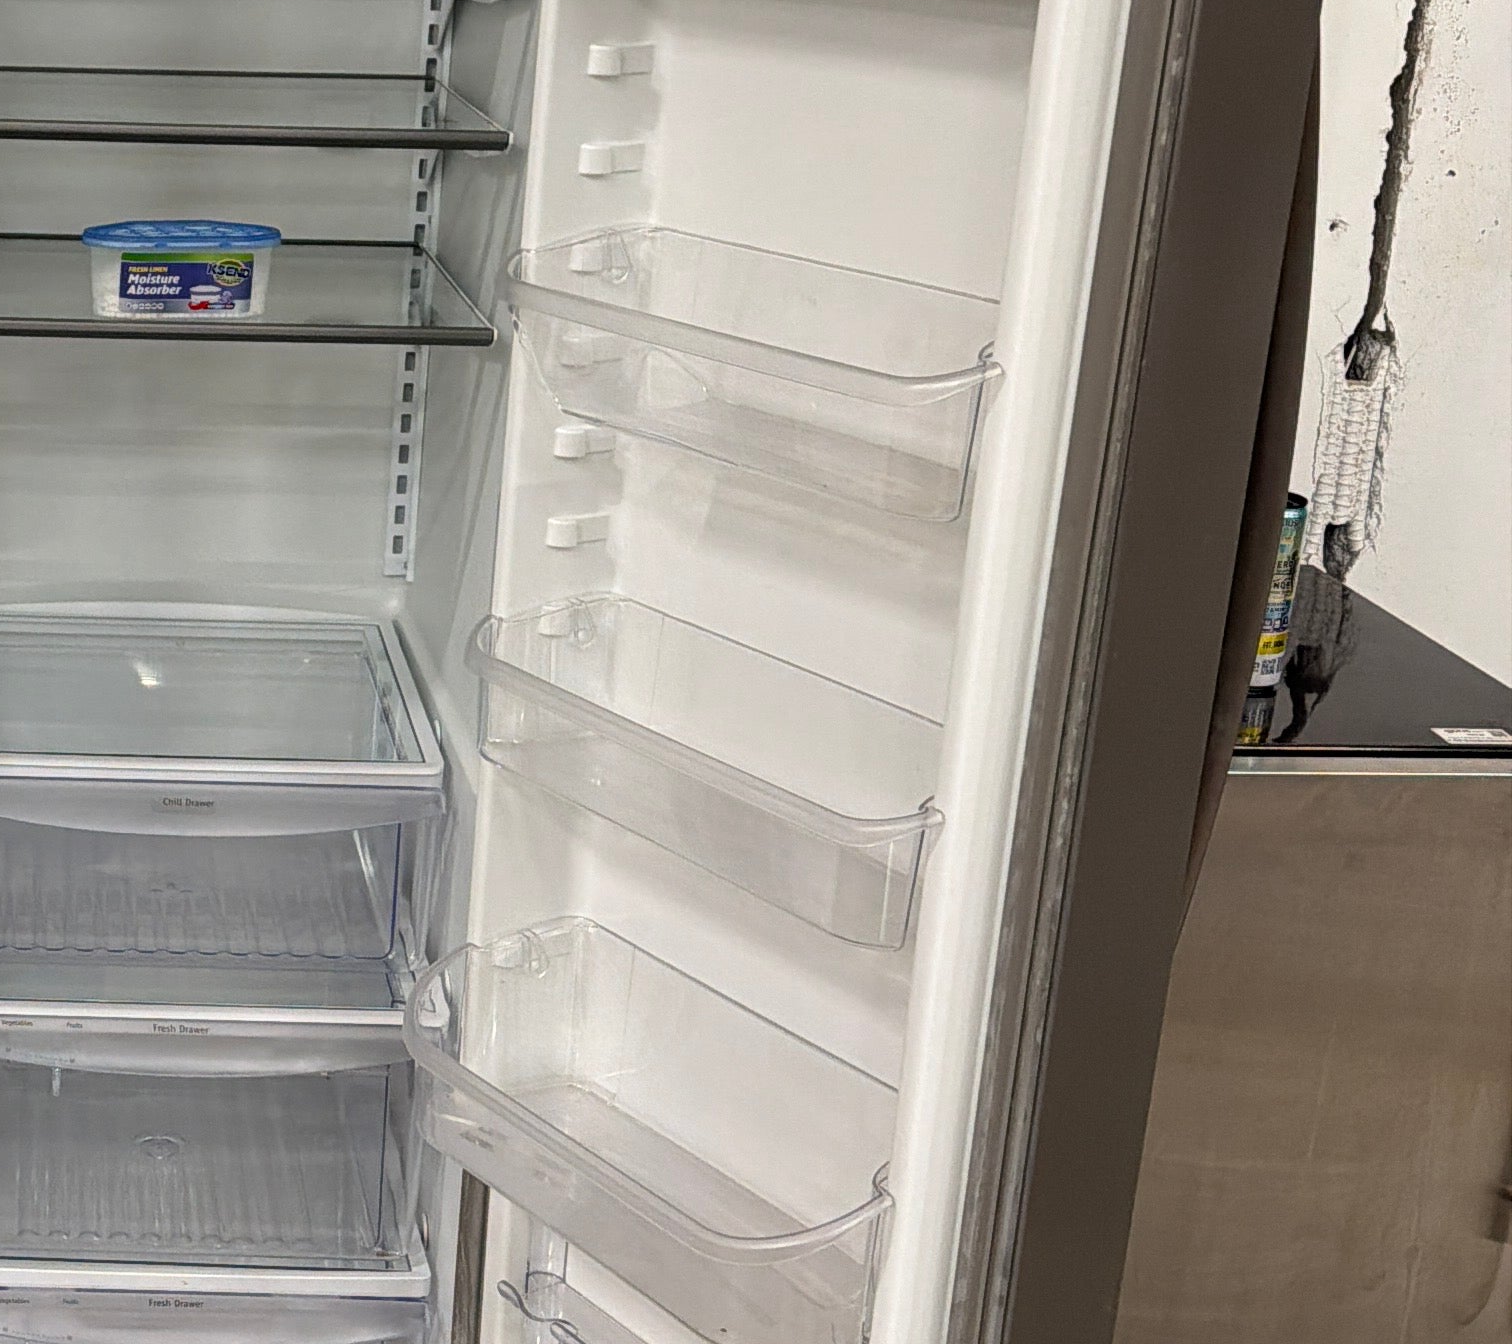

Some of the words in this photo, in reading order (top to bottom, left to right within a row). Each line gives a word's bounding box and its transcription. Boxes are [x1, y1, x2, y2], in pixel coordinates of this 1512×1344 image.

[127, 273, 180, 284] Moisture
[126, 285, 182, 295] Absorber
[162, 797, 183, 806] Chill
[185, 798, 215, 807] Drawer
[152, 1023, 177, 1033] Fresh
[179, 1024, 210, 1034] Drawer
[148, 1298, 172, 1307] Fresh
[174, 1299, 204, 1308] Drawer
